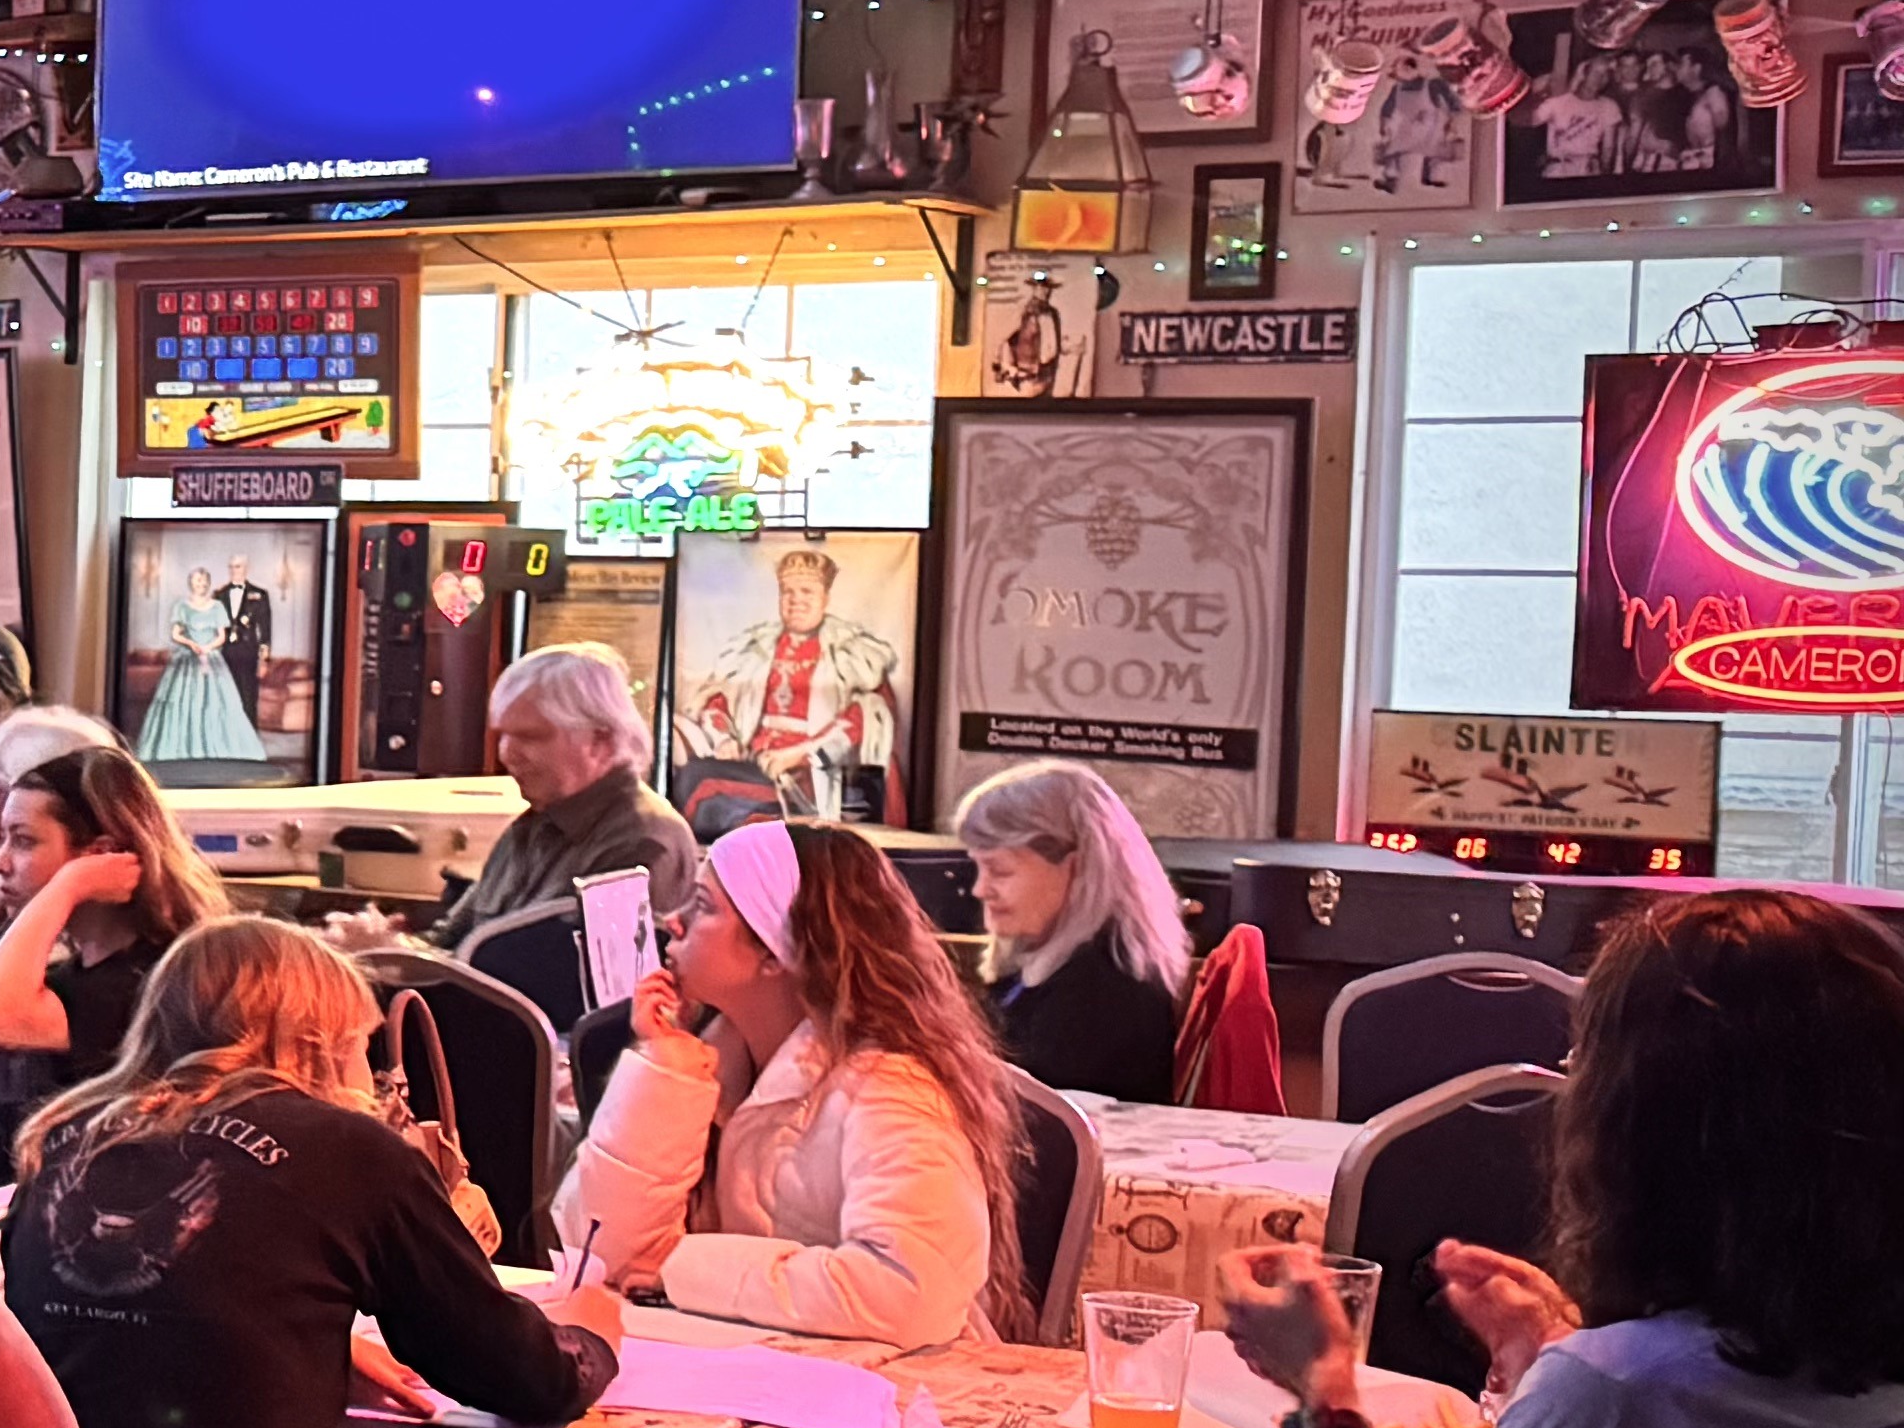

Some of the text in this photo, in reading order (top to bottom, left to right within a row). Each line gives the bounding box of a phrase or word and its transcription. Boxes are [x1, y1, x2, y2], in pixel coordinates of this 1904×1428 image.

[204, 163, 288, 186] Cameron's
[289, 161, 320, 181] Pub
[337, 156, 428, 180] Restaurant
[1132, 314, 1348, 352] NEWCASTLE
[586, 492, 759, 534] PALE ALE
[461, 539, 488, 574] 0
[525, 542, 549, 576] 0
[991, 573, 1230, 652] SMOKE
[1012, 643, 1212, 711] ROOM
[1088, 724, 1115, 740] the
[1120, 727, 1182, 745] World's
[1187, 731, 1224, 749] only
[1454, 722, 1617, 760] SLAINTE
[1454, 835, 1682, 872] 06 42 35
